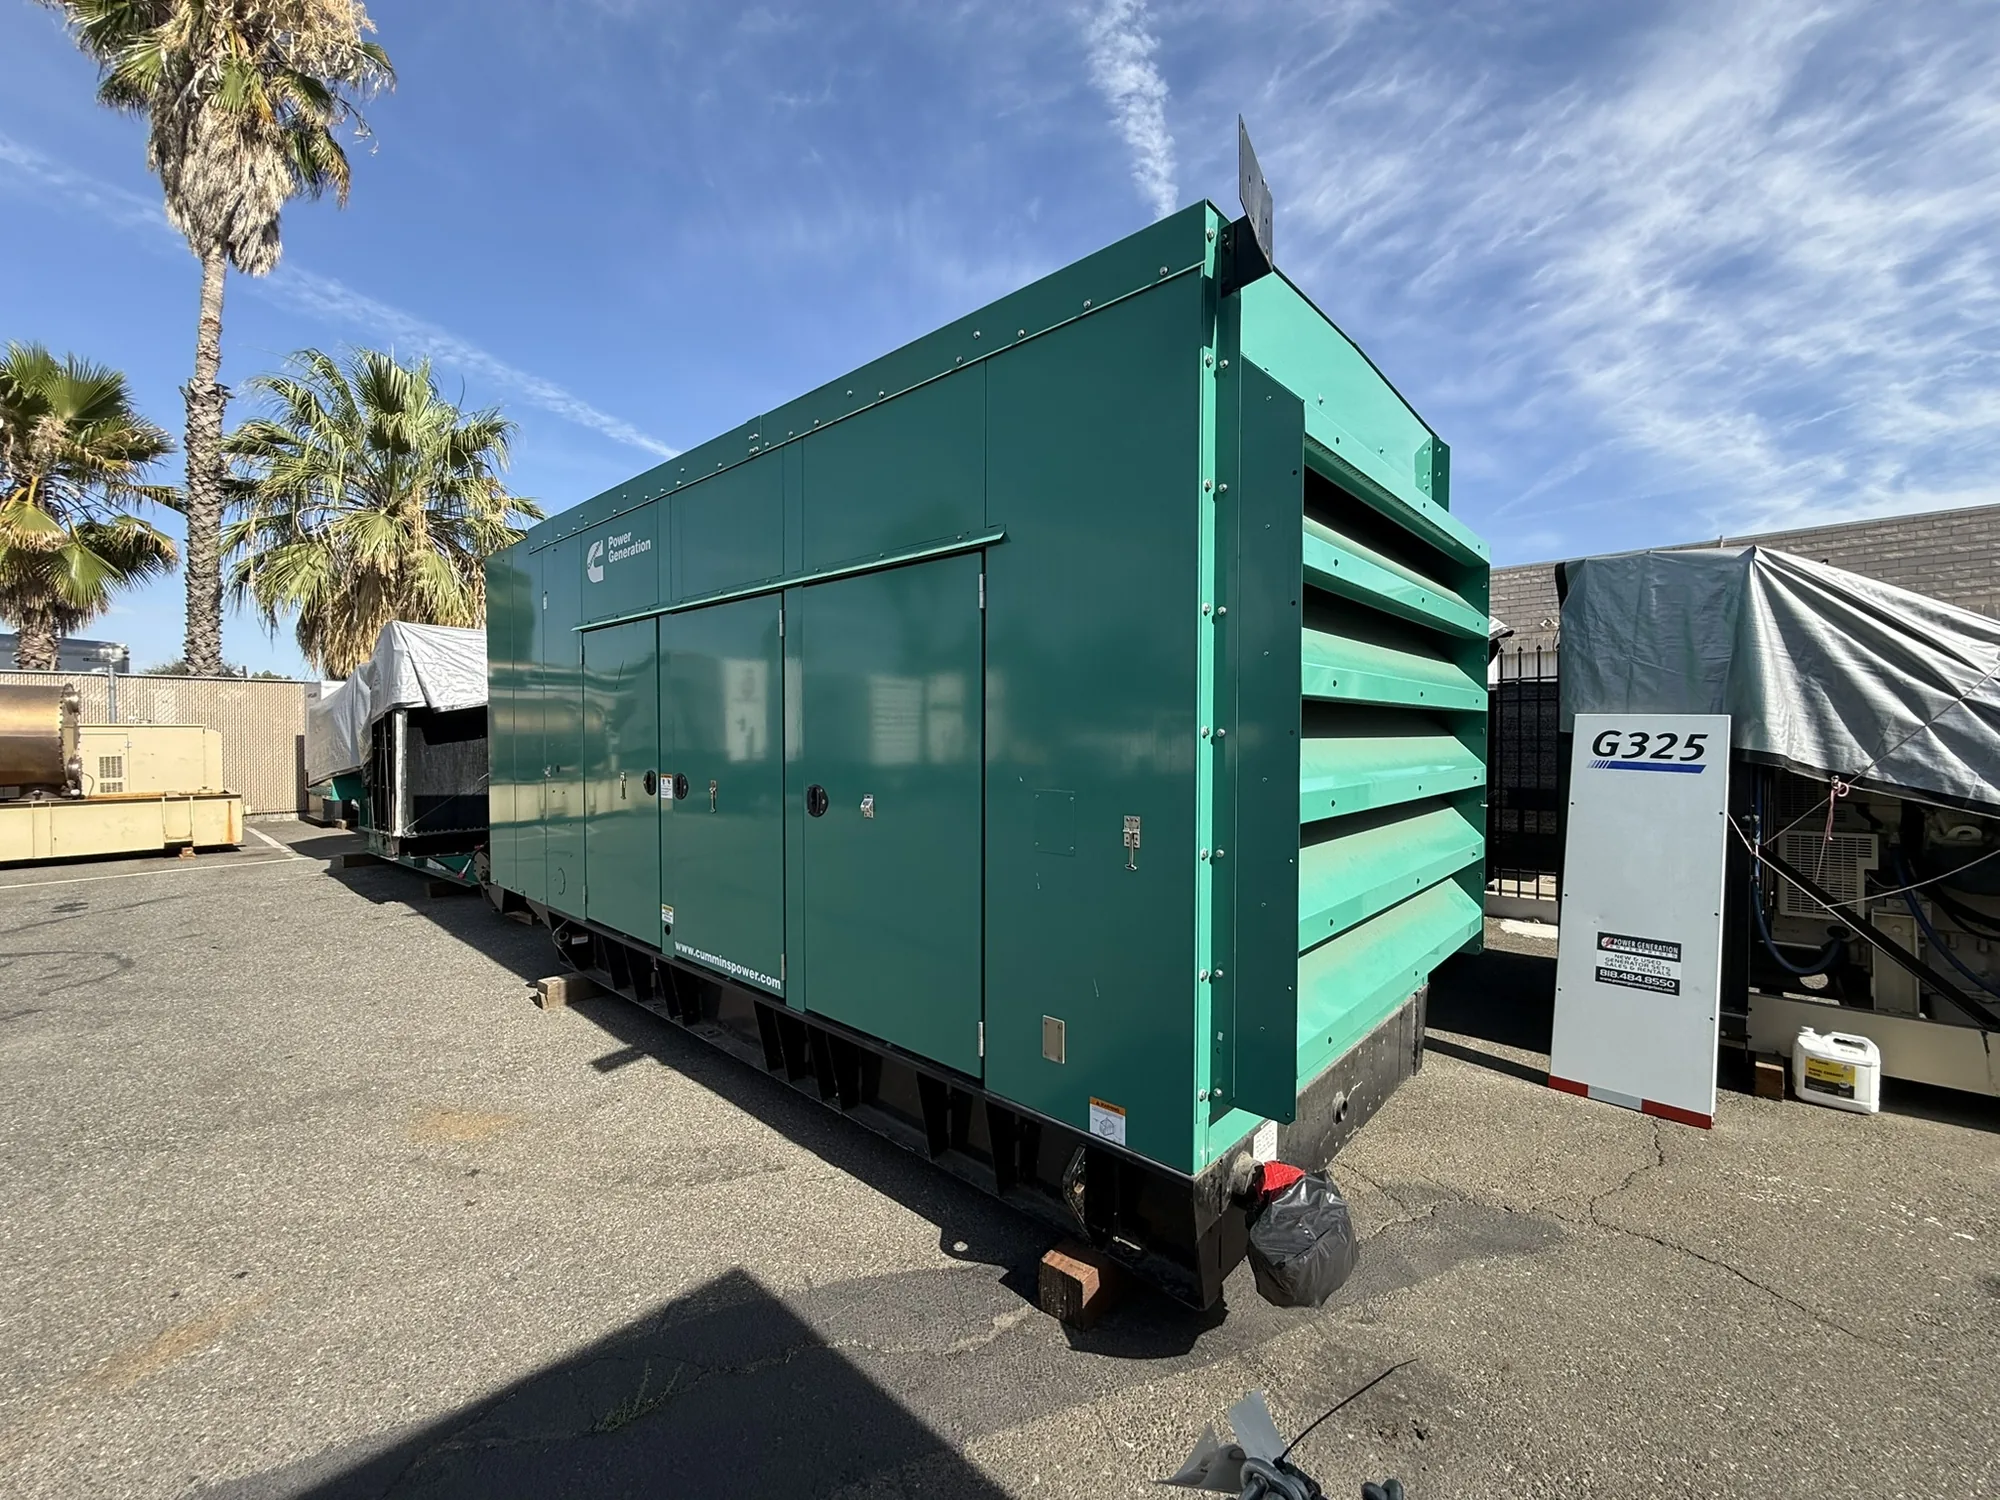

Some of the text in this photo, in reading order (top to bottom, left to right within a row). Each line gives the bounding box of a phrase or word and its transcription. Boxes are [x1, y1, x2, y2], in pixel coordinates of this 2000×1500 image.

[608, 532, 631, 549] Power
[608, 539, 651, 563] Generation
[1592, 730, 1709, 761] G325
[1614, 938, 1678, 954] POWER GENERATION
[674, 941, 781, 990] www.cumminspower.com
[1604, 961, 1627, 969] SALES
[1637, 967, 1671, 977] RENTALS
[1605, 957, 1671, 972] GENERATOR SETS
[1641, 957, 1661, 965] USED
[1600, 969, 1675, 988] 818.484.8550
